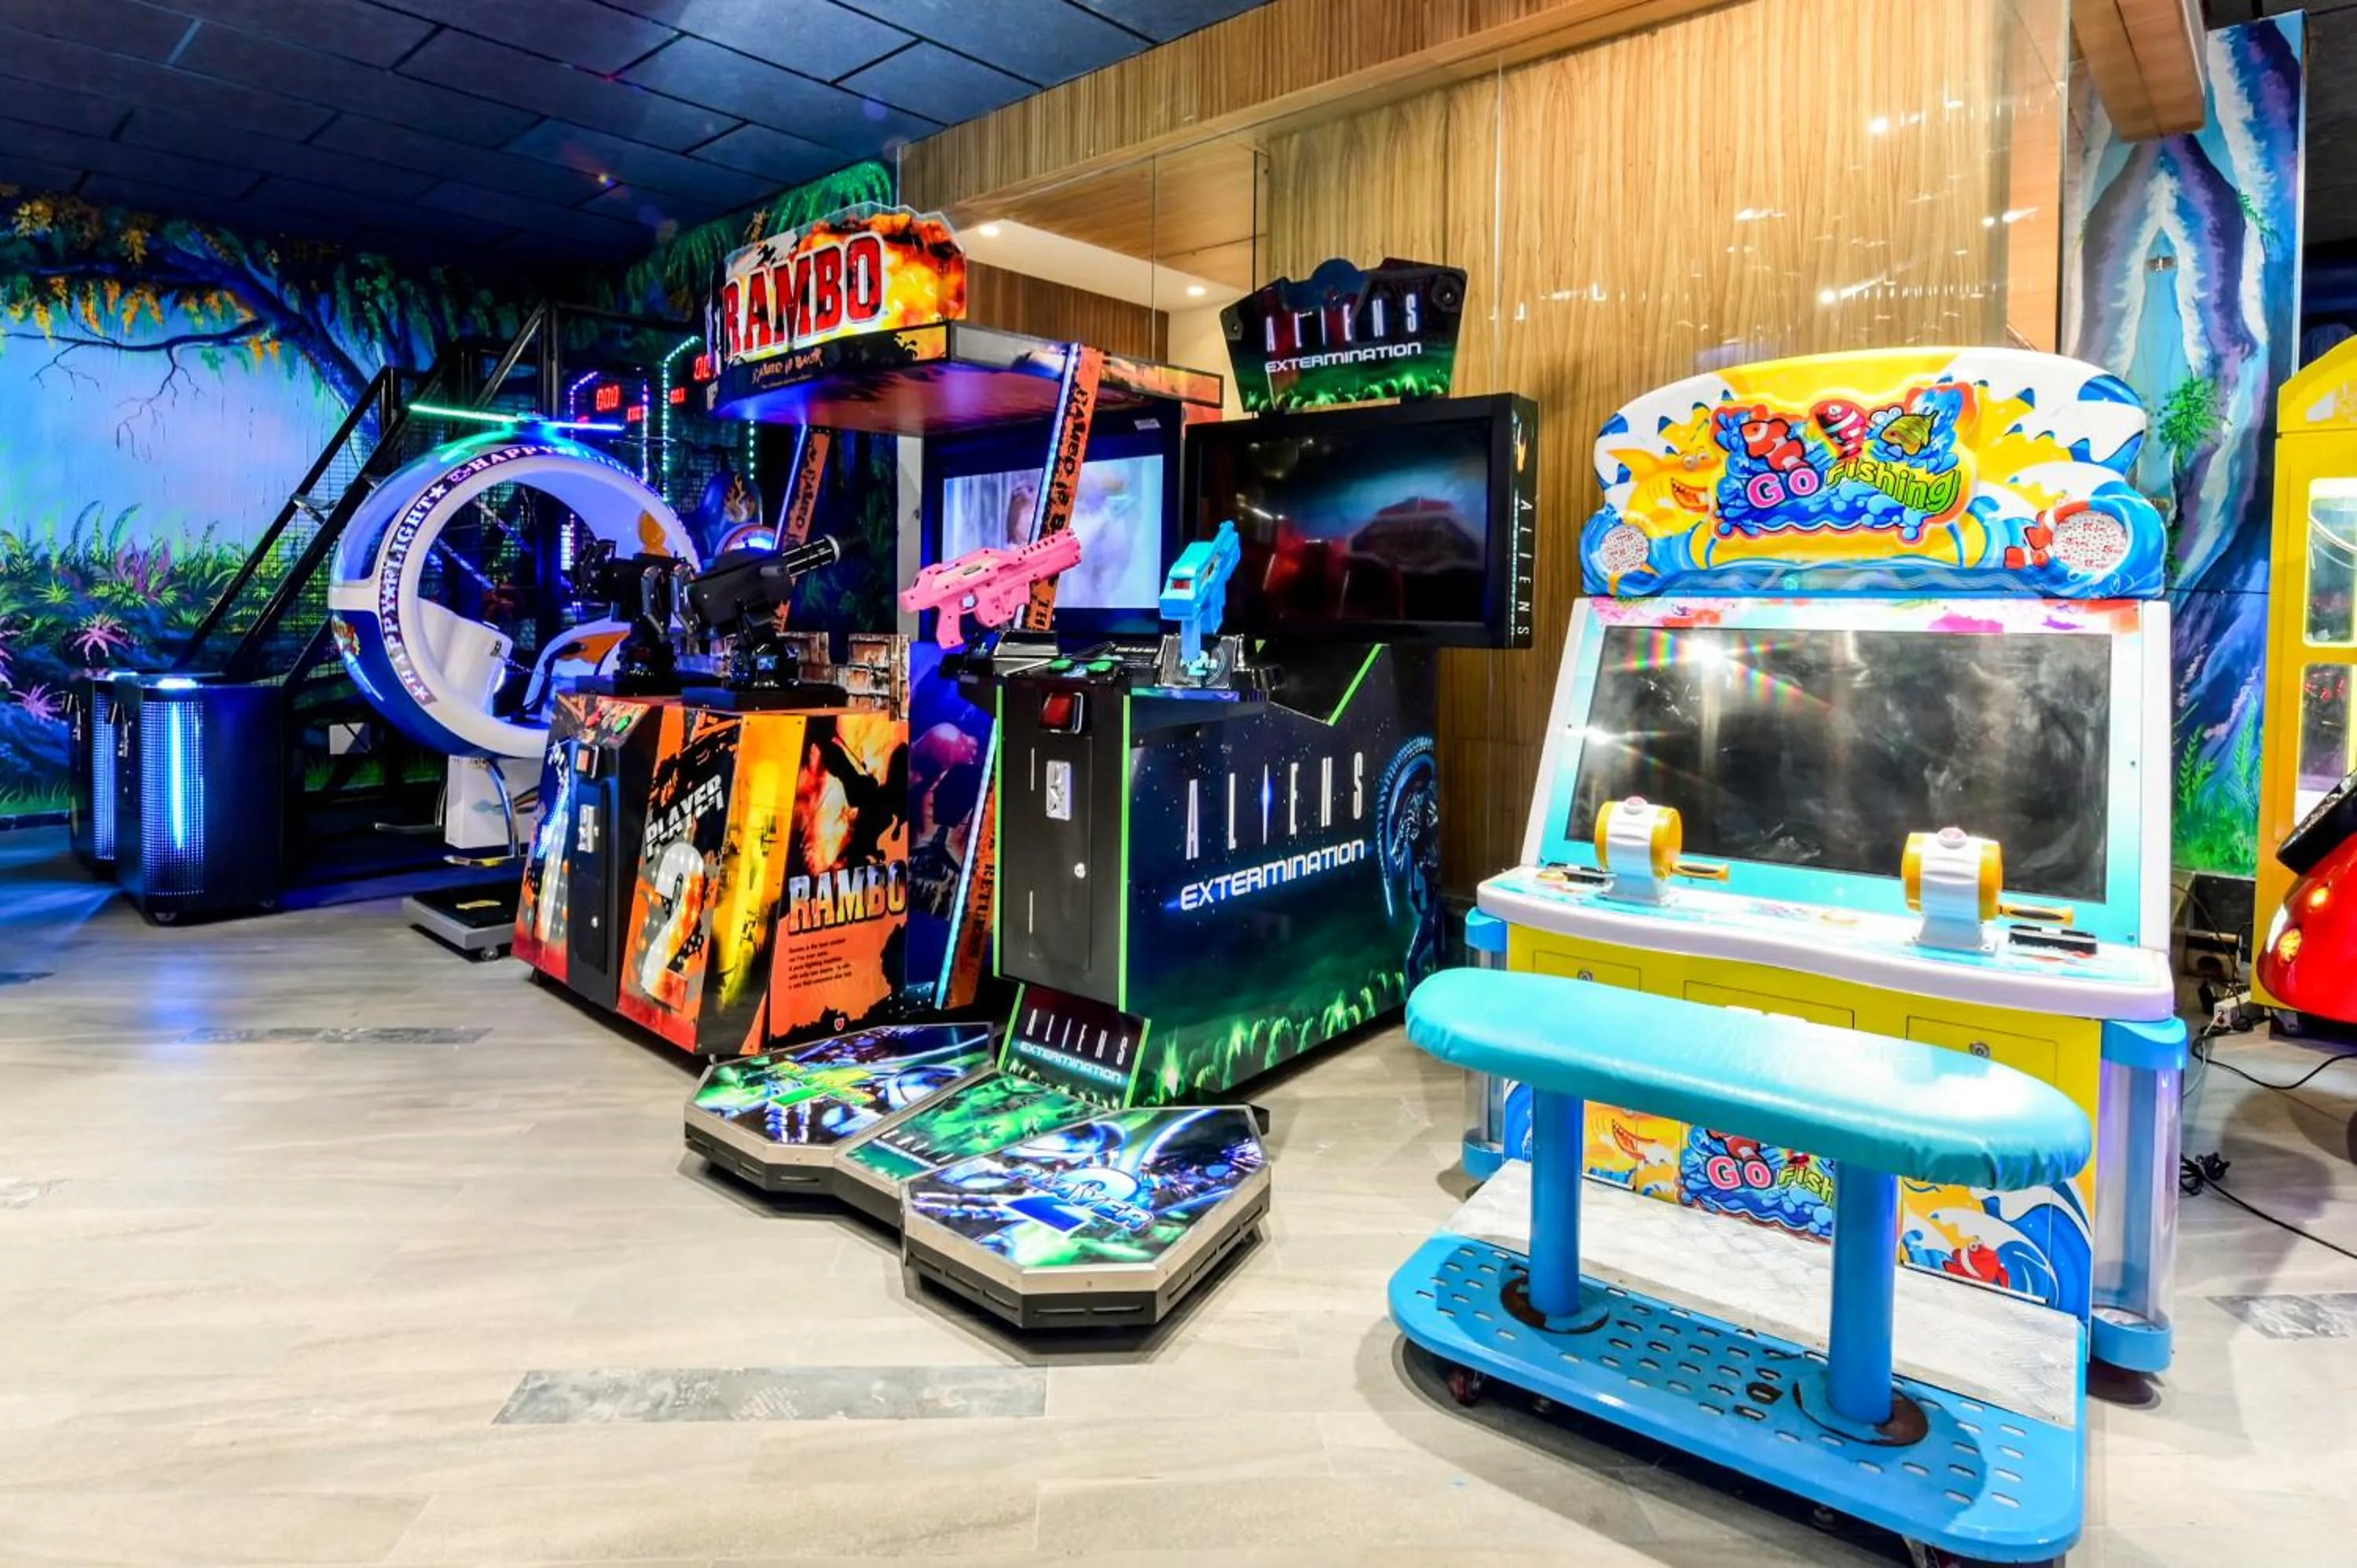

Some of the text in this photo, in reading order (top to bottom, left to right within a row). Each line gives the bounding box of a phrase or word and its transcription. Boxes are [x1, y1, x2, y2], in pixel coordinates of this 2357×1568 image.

[723, 235, 883, 361] RAMBO
[1265, 294, 1417, 353] ALIENS
[1264, 342, 1421, 373] EXTERMINATION
[468, 445, 553, 472] HAPPY
[383, 493, 438, 584] FLIGHT
[1517, 499, 1534, 636] ALIENS
[645, 774, 724, 859] PLAYER
[1186, 751, 1364, 860] ALIENS
[788, 859, 907, 935] RAMBO
[1180, 839, 1365, 911] EXTERMINATION
[640, 841, 705, 1015] 2
[1019, 1041, 1122, 1083] EXTERMINATION
[1025, 1008, 1128, 1065] ALIENS
